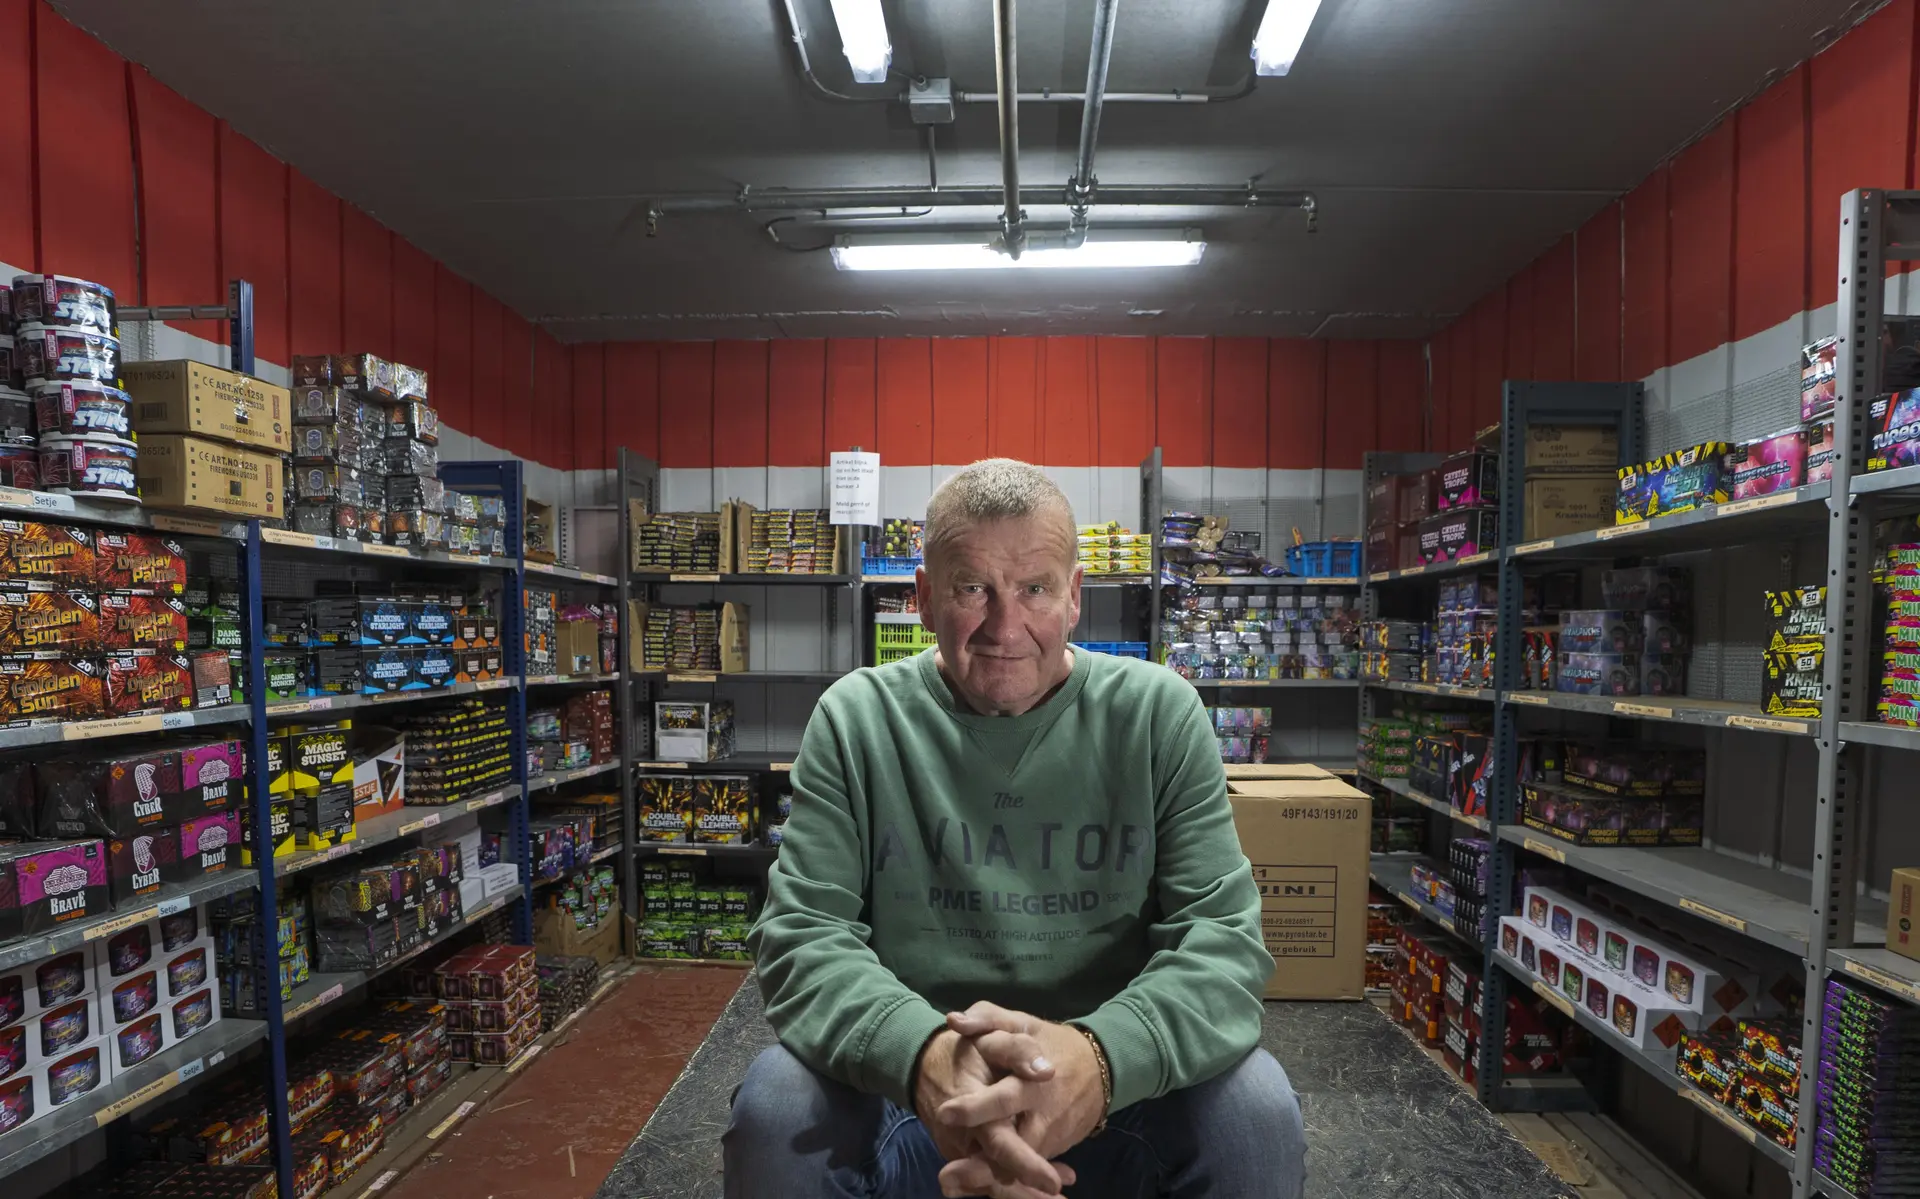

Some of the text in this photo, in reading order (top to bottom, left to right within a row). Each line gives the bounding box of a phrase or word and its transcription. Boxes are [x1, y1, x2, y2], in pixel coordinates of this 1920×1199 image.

[1870, 399, 1888, 414] 35
[1444, 468, 1469, 481] CRYSTAL
[1445, 477, 1467, 489] TROPIC
[35, 496, 57, 507] Setje
[71, 528, 85, 541] 20
[1442, 523, 1466, 534] CRYSTAL
[1442, 532, 1464, 542] TROPIC
[11, 539, 76, 557] Golden
[168, 541, 181, 553] 20
[1422, 540, 1439, 549] TROPIC
[18, 557, 54, 574] Sun
[117, 553, 172, 570] Display
[133, 568, 177, 582] Palms
[78, 595, 93, 607] 20
[169, 598, 183, 610] 20
[1806, 593, 1816, 602] 50
[15, 608, 82, 629] Golden
[118, 612, 173, 630] Display
[370, 622, 405, 630] STARLIGHT
[23, 628, 61, 645] Sun
[134, 625, 179, 642] Palms
[77, 660, 92, 672] 20
[175, 655, 188, 667] 20
[376, 662, 404, 671] BLINKING
[423, 660, 447, 668] BLINKING
[1801, 658, 1812, 666] 50
[372, 670, 408, 679] STARLIGHT
[421, 666, 450, 675] STARLIGHT
[12, 674, 81, 697] Golden
[127, 670, 179, 692] Display
[142, 682, 185, 702] Palms
[20, 696, 58, 714] Sun
[1888, 704, 1919, 720] MINI
[163, 717, 182, 726] Setje
[305, 741, 343, 755] MAGIC
[301, 751, 347, 766] SUNSET
[203, 782, 228, 801] BRAVE
[1586, 780, 1618, 793] AORTMENT
[993, 792, 1024, 809] The
[133, 797, 162, 818] CYBER
[1282, 808, 1358, 820] 49F143/191/20
[703, 814, 737, 822] DOUBLE
[1544, 825, 1575, 841] AORTMENT
[876, 818, 1150, 872] AVIATOR
[202, 847, 226, 868] BRAVE
[132, 868, 160, 890] CYBER
[50, 890, 86, 916] BRAVE
[929, 886, 1099, 916] PME LEGEND
[160, 905, 177, 915] Setje
[946, 927, 1080, 942] TESTED AT HIGH ALTITUDE
[1266, 931, 1327, 939] www.pyrostar.be
[1283, 946, 1316, 954] gebruik
[184, 1065, 200, 1077] Setje
